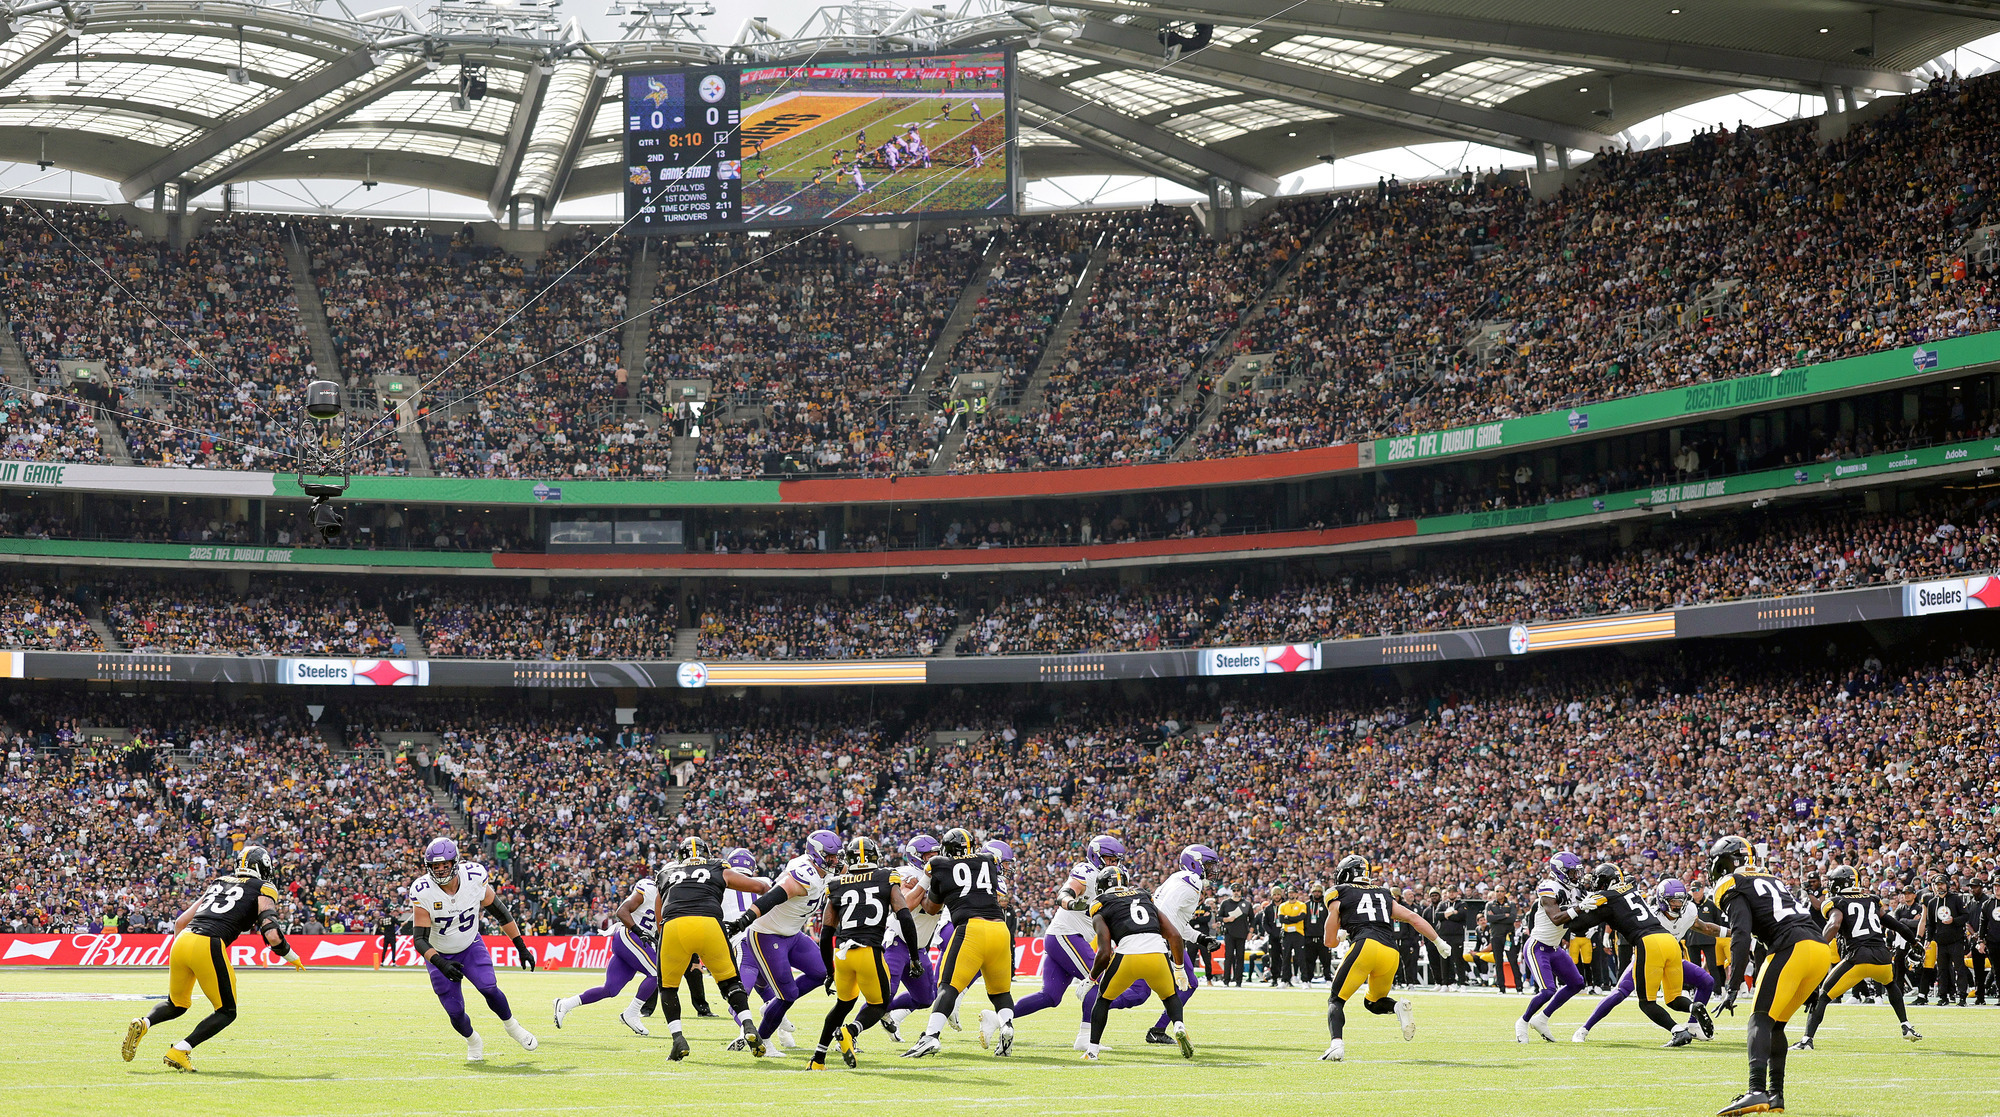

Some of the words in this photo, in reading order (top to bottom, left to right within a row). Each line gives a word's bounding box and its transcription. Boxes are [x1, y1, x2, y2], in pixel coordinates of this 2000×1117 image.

[651, 111, 664, 129] 0
[706, 107, 719, 126] 0
[638, 139, 654, 147] QTR
[655, 138, 660, 146] 1
[669, 132, 702, 148] 8:10
[647, 153, 664, 162] 2ND
[716, 150, 726, 158] 13
[659, 167, 685, 180] GAME
[686, 165, 712, 179] STATS
[665, 184, 689, 193] TOTAL
[690, 183, 705, 191] YDS
[664, 195, 678, 203] 1ST
[679, 193, 707, 202] DOWNS
[721, 191, 727, 199] 0
[661, 204, 678, 213] TIME
[679, 203, 689, 212] OF
[690, 202, 710, 211] POSS
[716, 201, 732, 210] 2:11
[645, 215, 651, 223] 0
[663, 212, 708, 223] TURNOVERS
[721, 211, 727, 219] 0
[1685, 387, 1711, 411] 2025
[1712, 384, 1732, 406] NFL
[1735, 374, 1774, 403] DUBLIN
[1776, 368, 1809, 397] GAME
[1388, 437, 1416, 461] 2025
[1418, 433, 1437, 457] NFL
[1440, 427, 1475, 454] DUBLIN
[1476, 423, 1504, 448] GAME
[1945, 449, 1968, 459] Adobe
[1889, 457, 1918, 469] accenture
[0, 463, 19, 483] IN
[23, 464, 66, 485] GAME
[1650, 491, 1667, 505] 2025
[1668, 488, 1681, 502] NFL
[1682, 483, 1705, 500] DUBLIN
[1706, 480, 1726, 496] GAME
[189, 547, 212, 560] 2025
[214, 548, 231, 560] NFL
[233, 549, 265, 561] DUBLIN
[266, 550, 293, 563] GAME
[1919, 588, 1962, 608] Steelers
[97, 663, 172, 671] PITTSBURGH
[1215, 652, 1261, 669] Steelers
[298, 663, 348, 679] Steelers
[513, 671, 587, 679] PITTSBURGH
[840, 871, 874, 885] ELLIOTT
[952, 861, 993, 898] 94
[840, 886, 884, 930] 25
[1129, 899, 1150, 925] 6
[1356, 893, 1390, 924] 41
[434, 907, 475, 935] 75
[1847, 901, 1882, 938] 26
[72, 934, 172, 966] Bud
[569, 935, 613, 967] Bud
